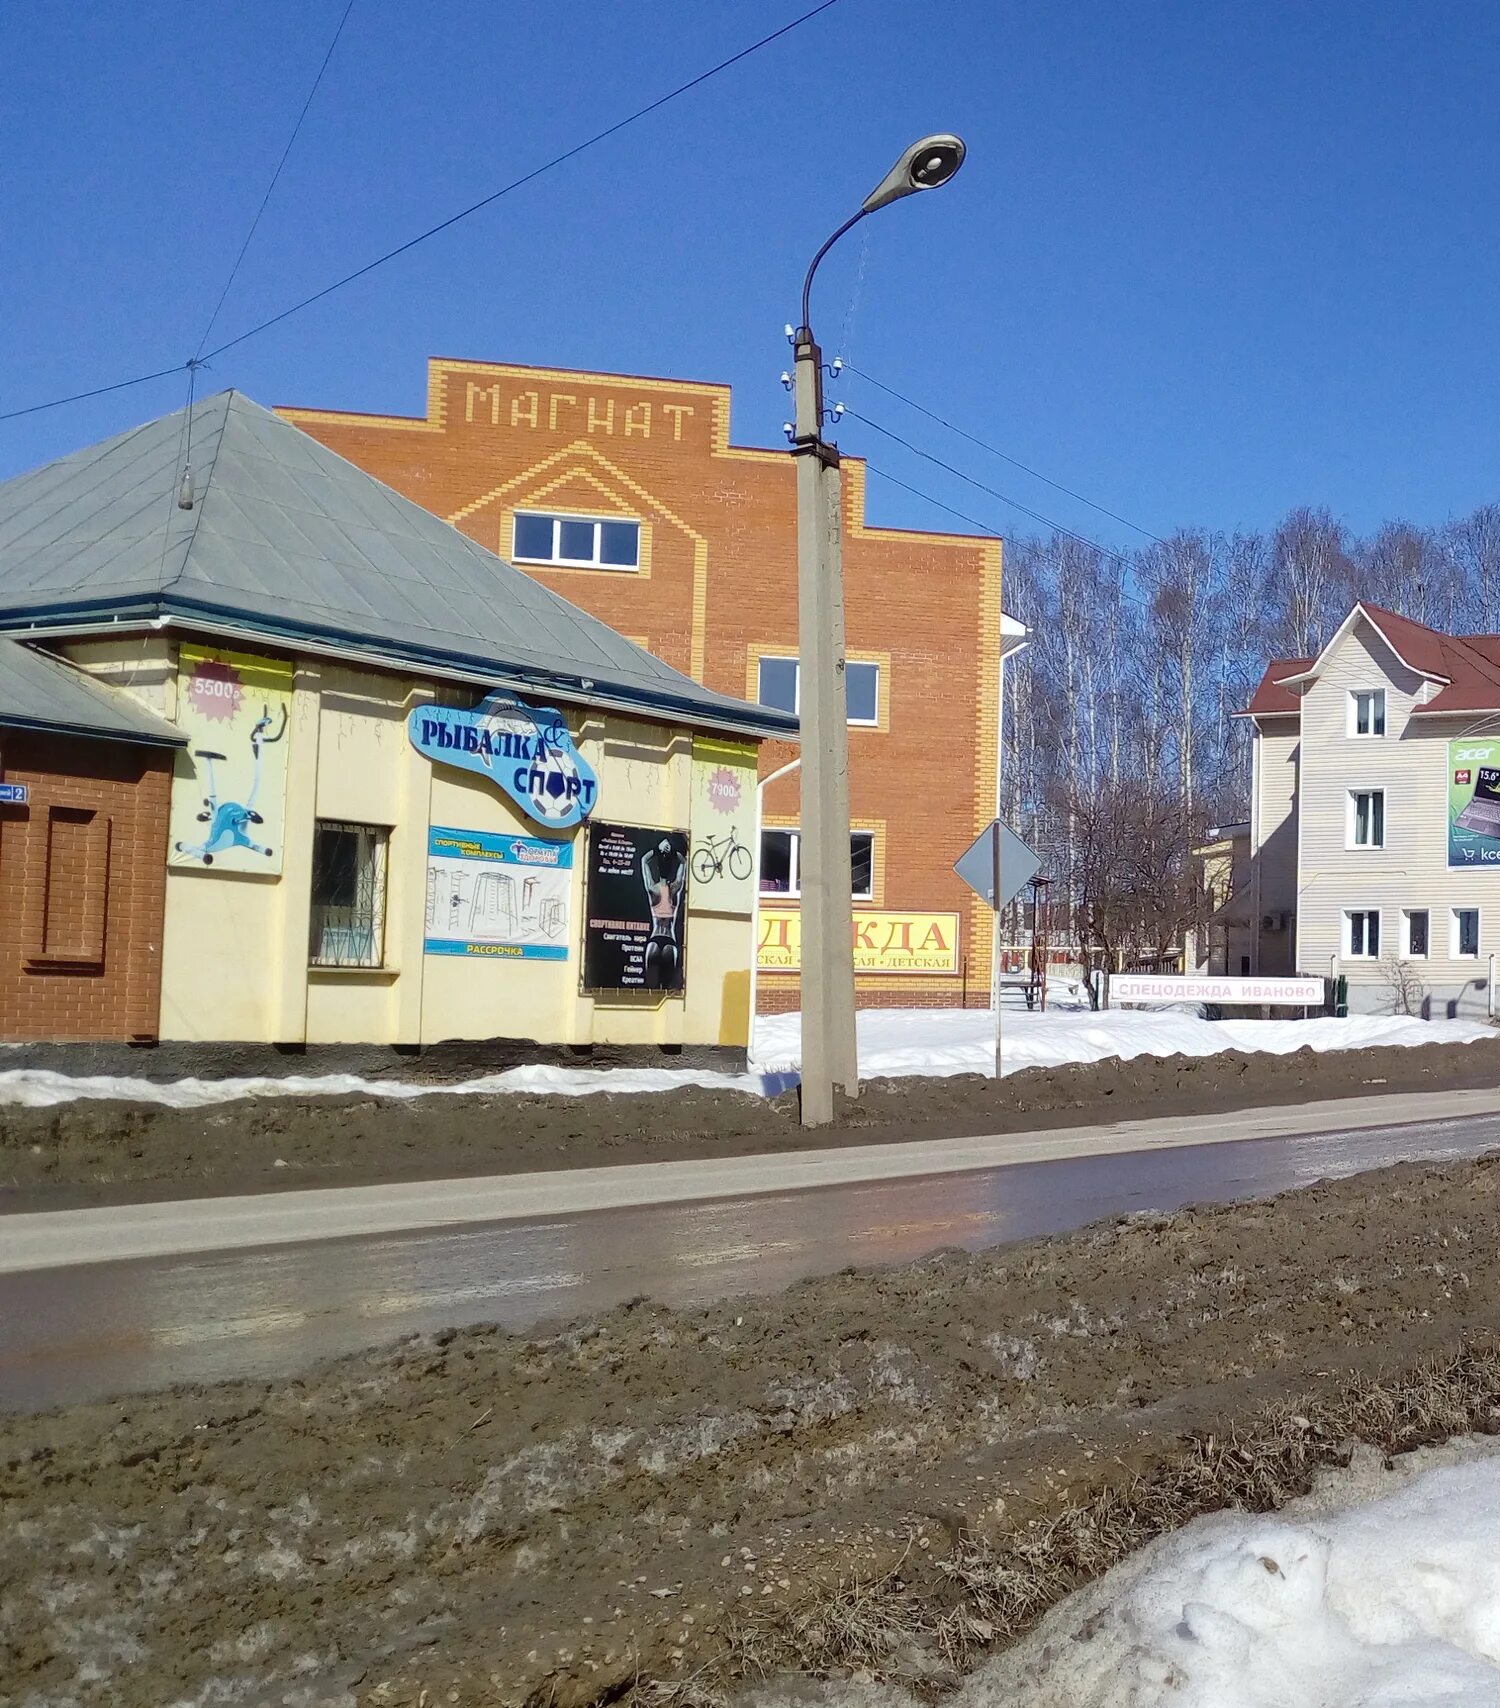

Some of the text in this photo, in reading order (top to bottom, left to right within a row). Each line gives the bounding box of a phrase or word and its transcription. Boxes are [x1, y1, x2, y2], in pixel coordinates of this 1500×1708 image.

[466, 382, 694, 440] МАГНАТ
[421, 719, 548, 763] РЫБАЛКА
[1455, 747, 1495, 760] acer
[15, 787, 23, 800] 2
[466, 945, 523, 956] РАССРОЧКА
[887, 957, 950, 968] ДЕТСКАЯ
[1119, 984, 1315, 998] СПЕЦОДЕЖДА ИВАНОВО
